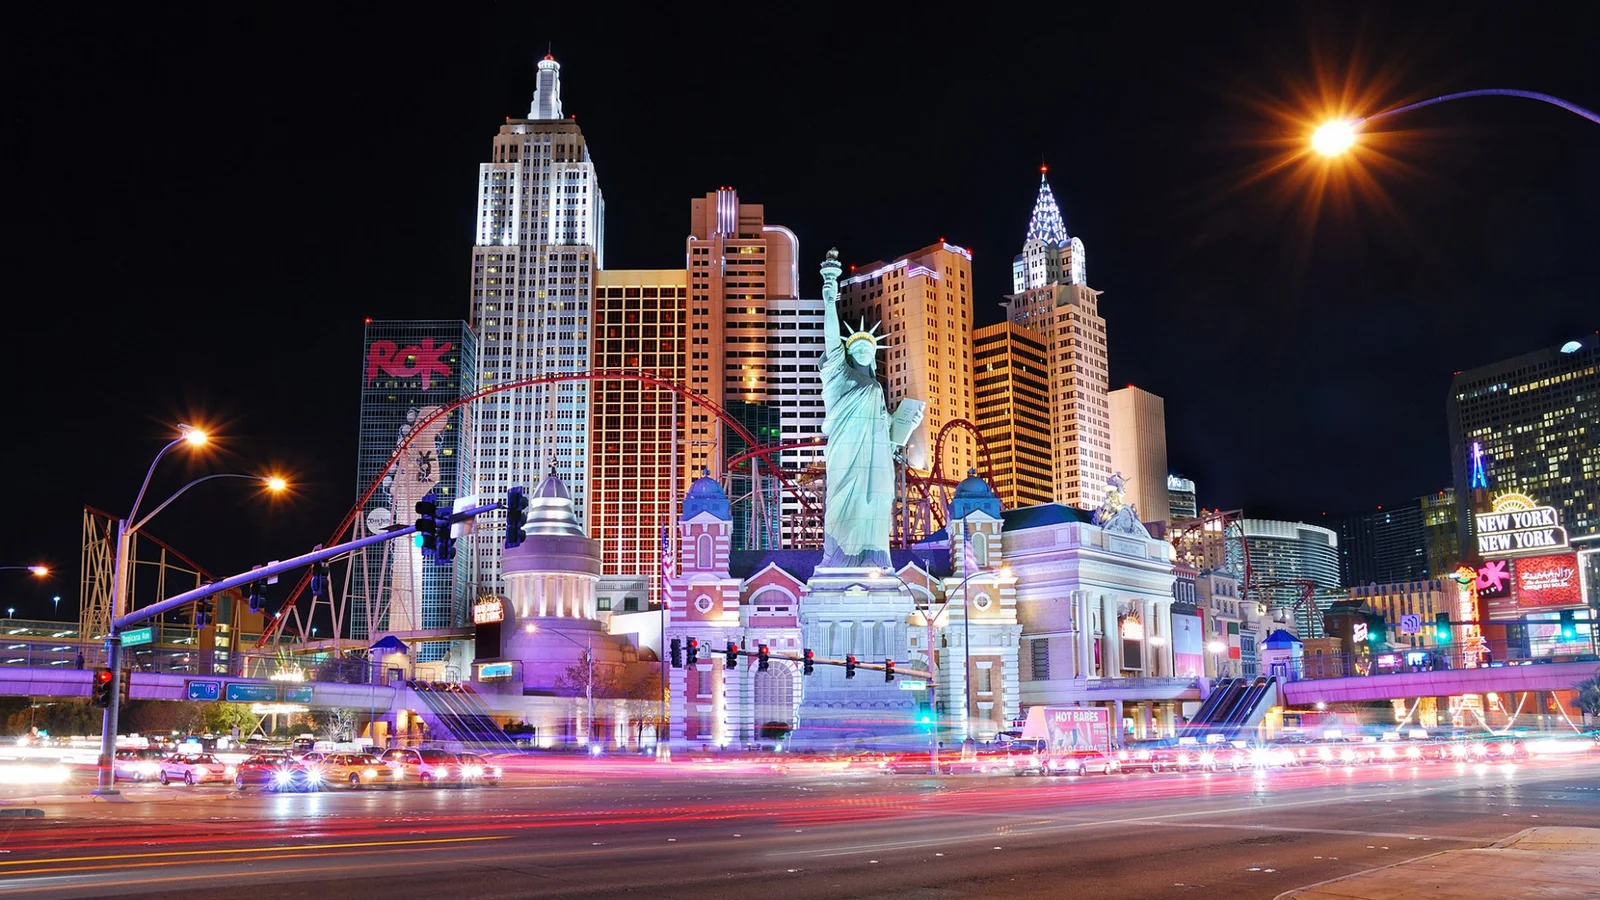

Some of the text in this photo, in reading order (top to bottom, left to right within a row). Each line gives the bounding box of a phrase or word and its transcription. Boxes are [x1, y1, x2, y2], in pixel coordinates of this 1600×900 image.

[1476, 509, 1554, 533] NEW YORK
[1478, 529, 1556, 552] NEW YORK
[1055, 711, 1099, 722] HOT BABES
